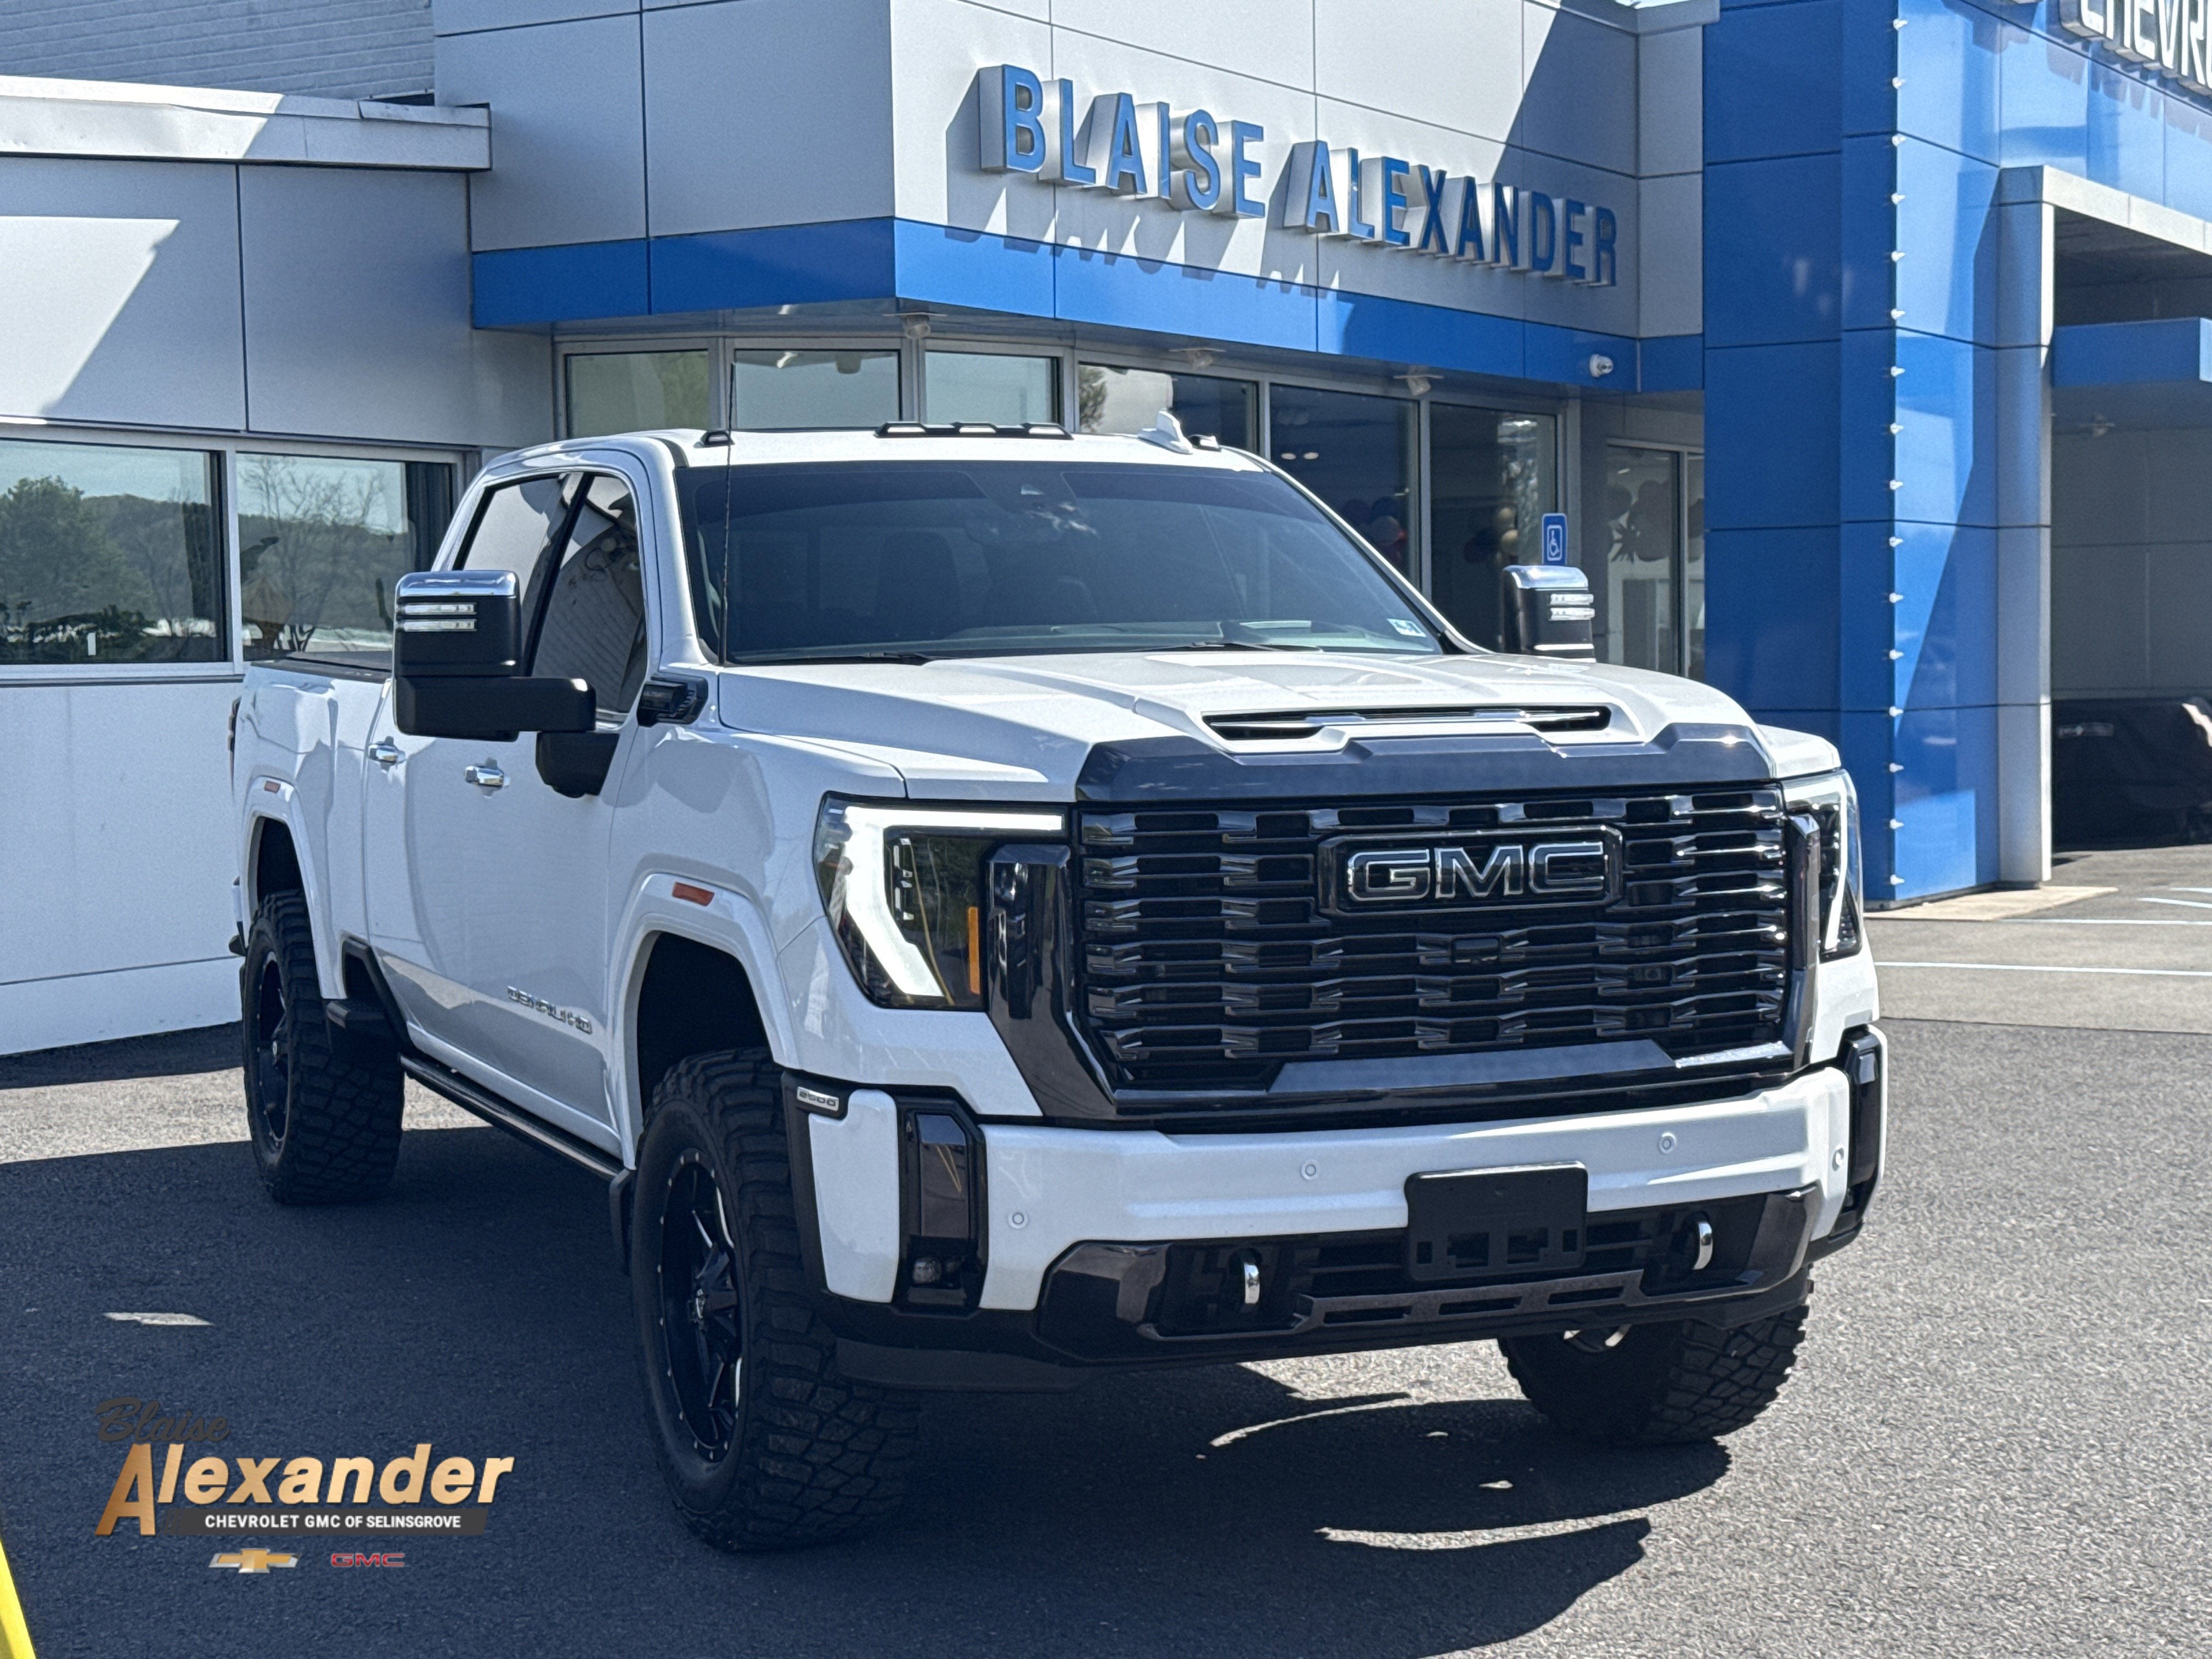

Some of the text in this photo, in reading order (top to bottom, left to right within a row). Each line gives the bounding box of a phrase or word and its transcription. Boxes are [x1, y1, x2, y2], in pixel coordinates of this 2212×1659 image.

[2081, 0, 2212, 89] EVR
[1002, 64, 1616, 286] BLAISE ALEXANDER
[1348, 841, 1604, 901] GMC
[799, 1090, 836, 1107] 2500
